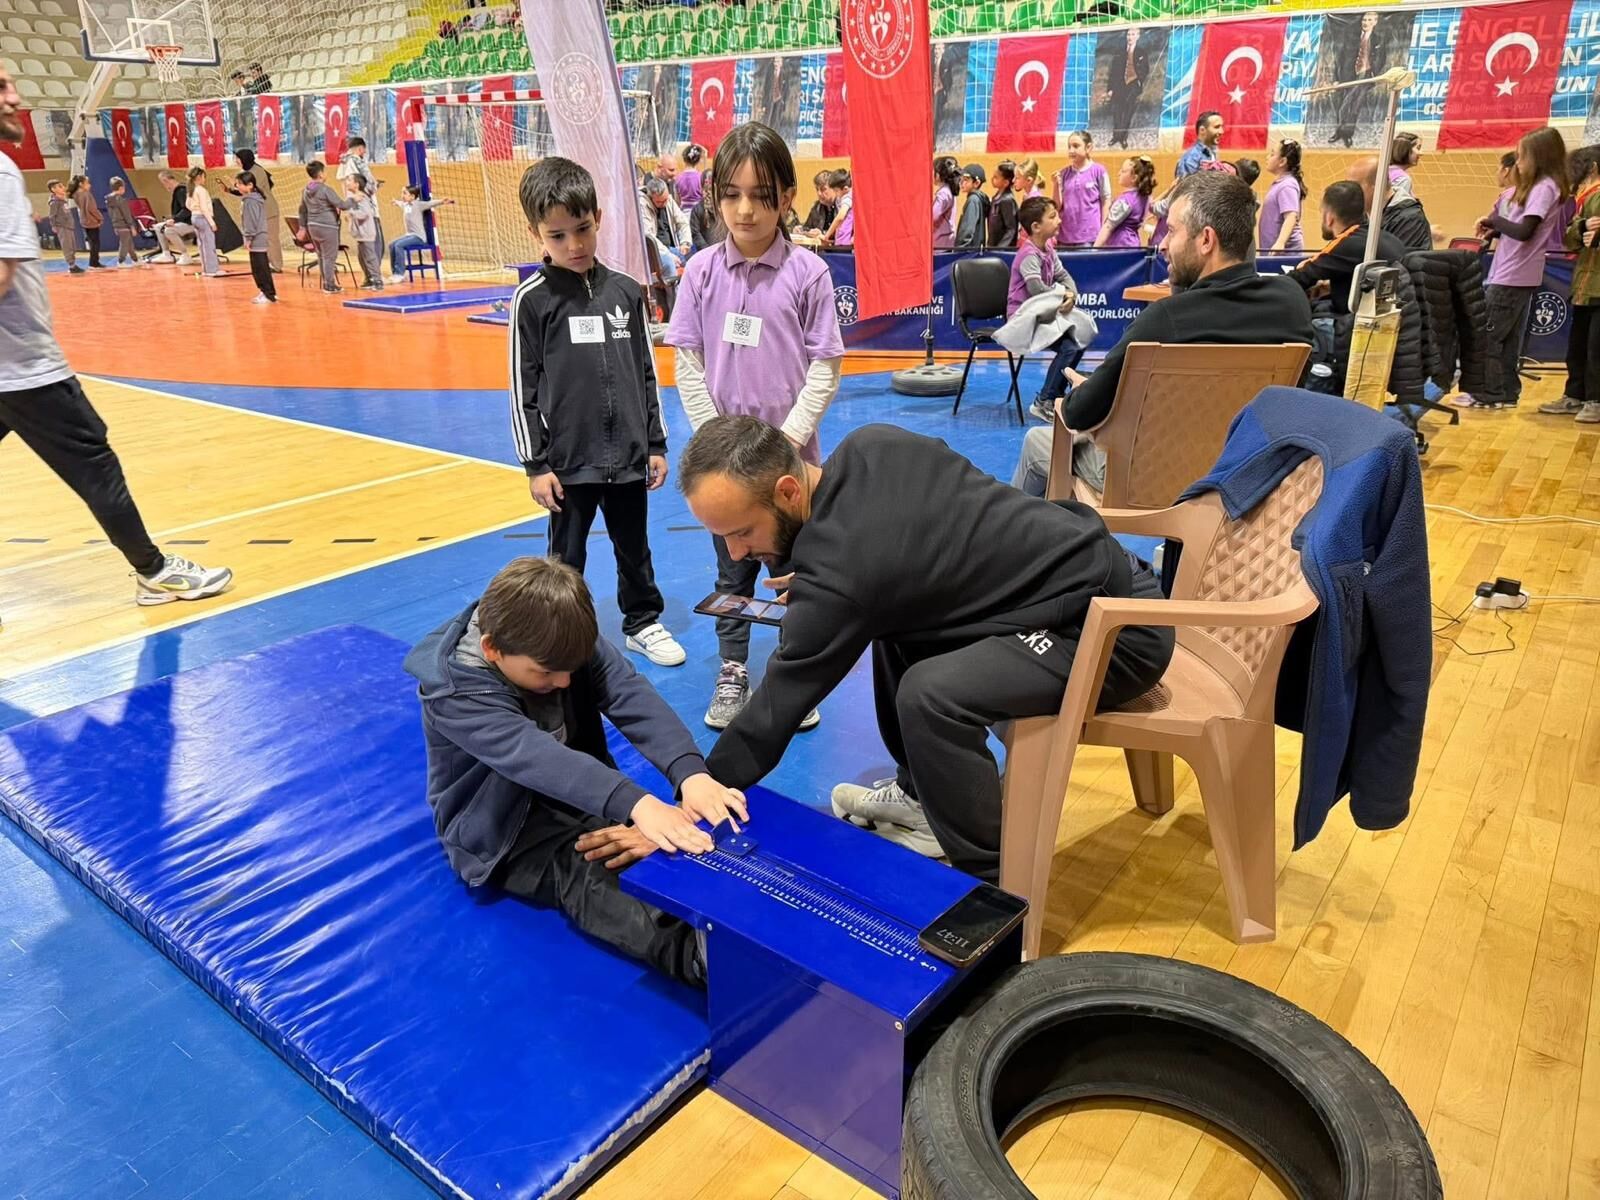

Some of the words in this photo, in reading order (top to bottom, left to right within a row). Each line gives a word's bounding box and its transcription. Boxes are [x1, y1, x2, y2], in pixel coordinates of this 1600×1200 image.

[932, 295, 944, 304] VE
[611, 329, 632, 339] adidas
[936, 928, 971, 948] 11:47
